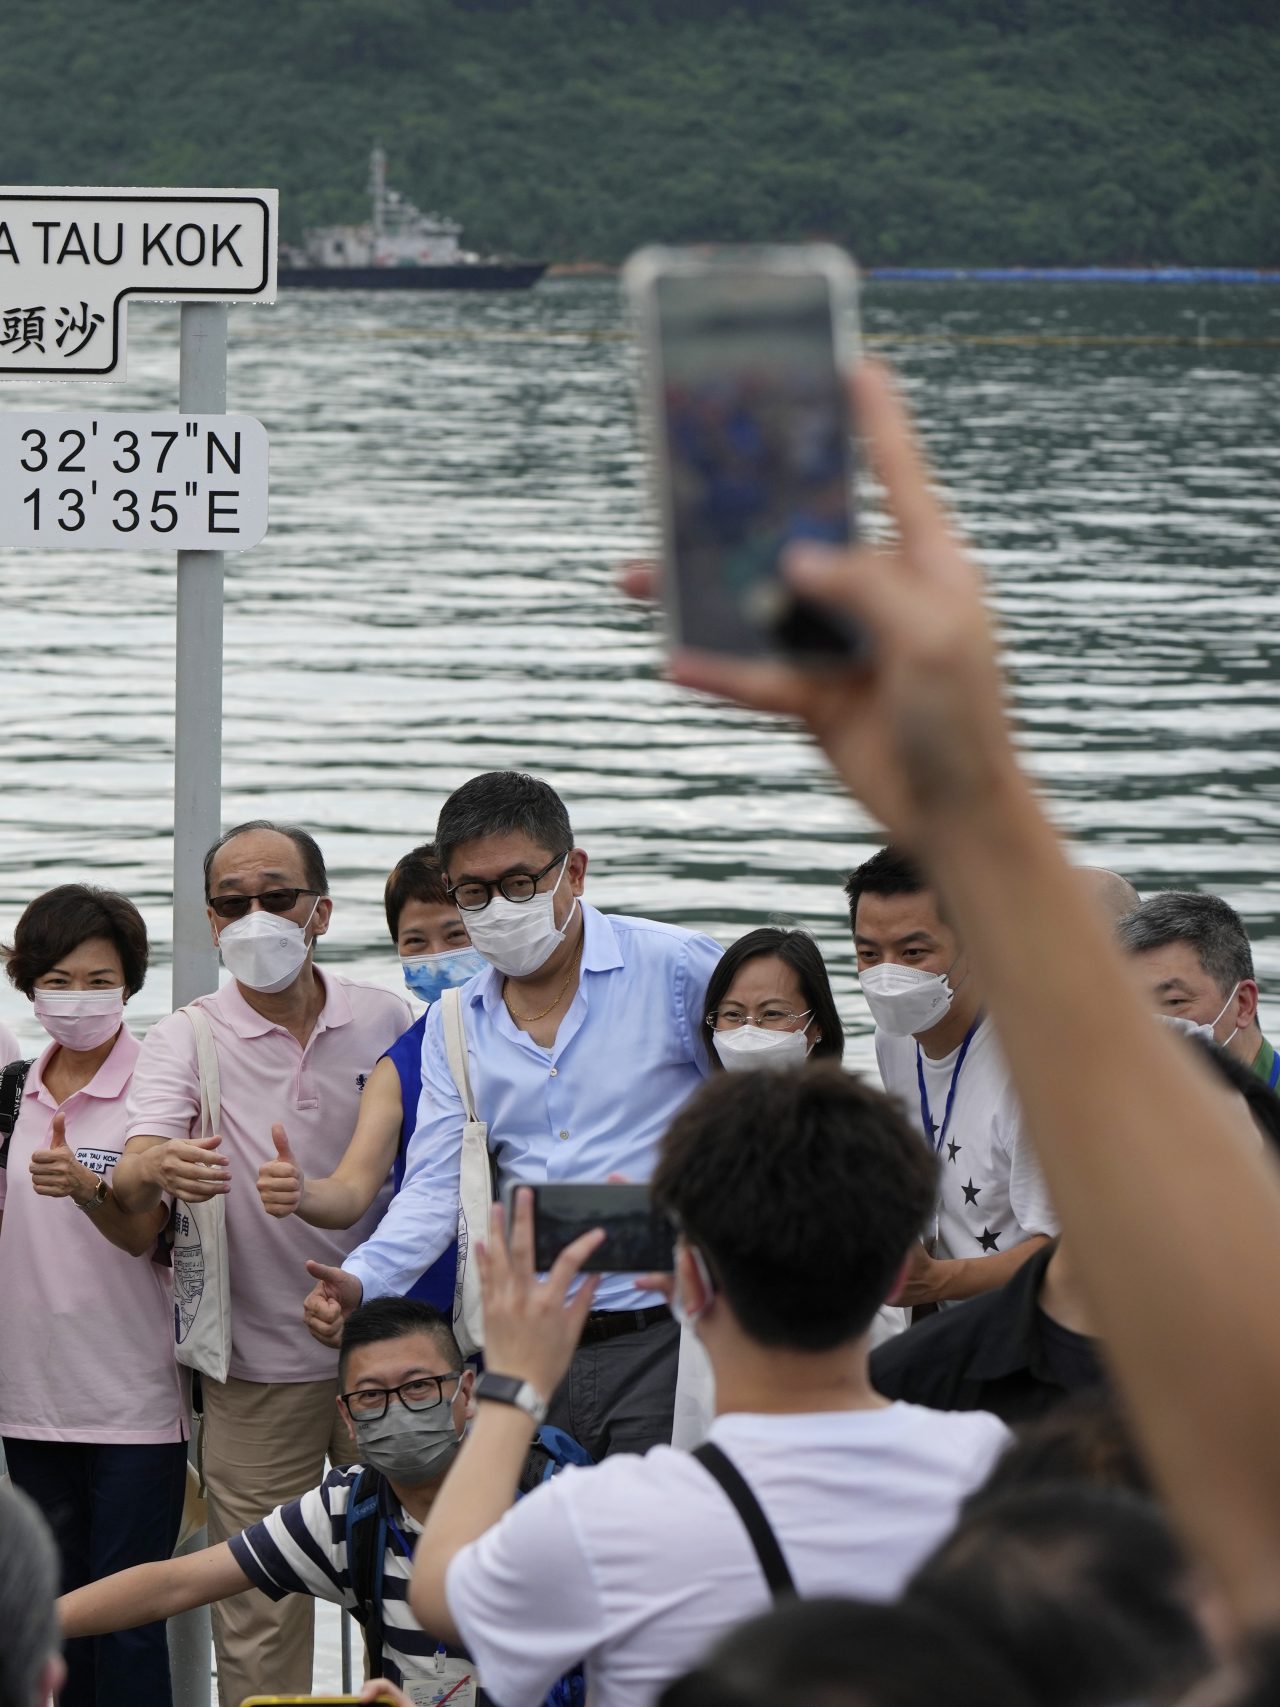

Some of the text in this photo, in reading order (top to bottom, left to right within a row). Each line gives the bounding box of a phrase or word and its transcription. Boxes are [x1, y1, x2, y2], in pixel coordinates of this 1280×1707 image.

[32, 221, 124, 266] TAU
[142, 223, 244, 267] KOK
[90, 1153, 101, 1161] TAU
[102, 1155, 118, 1163] KOK
